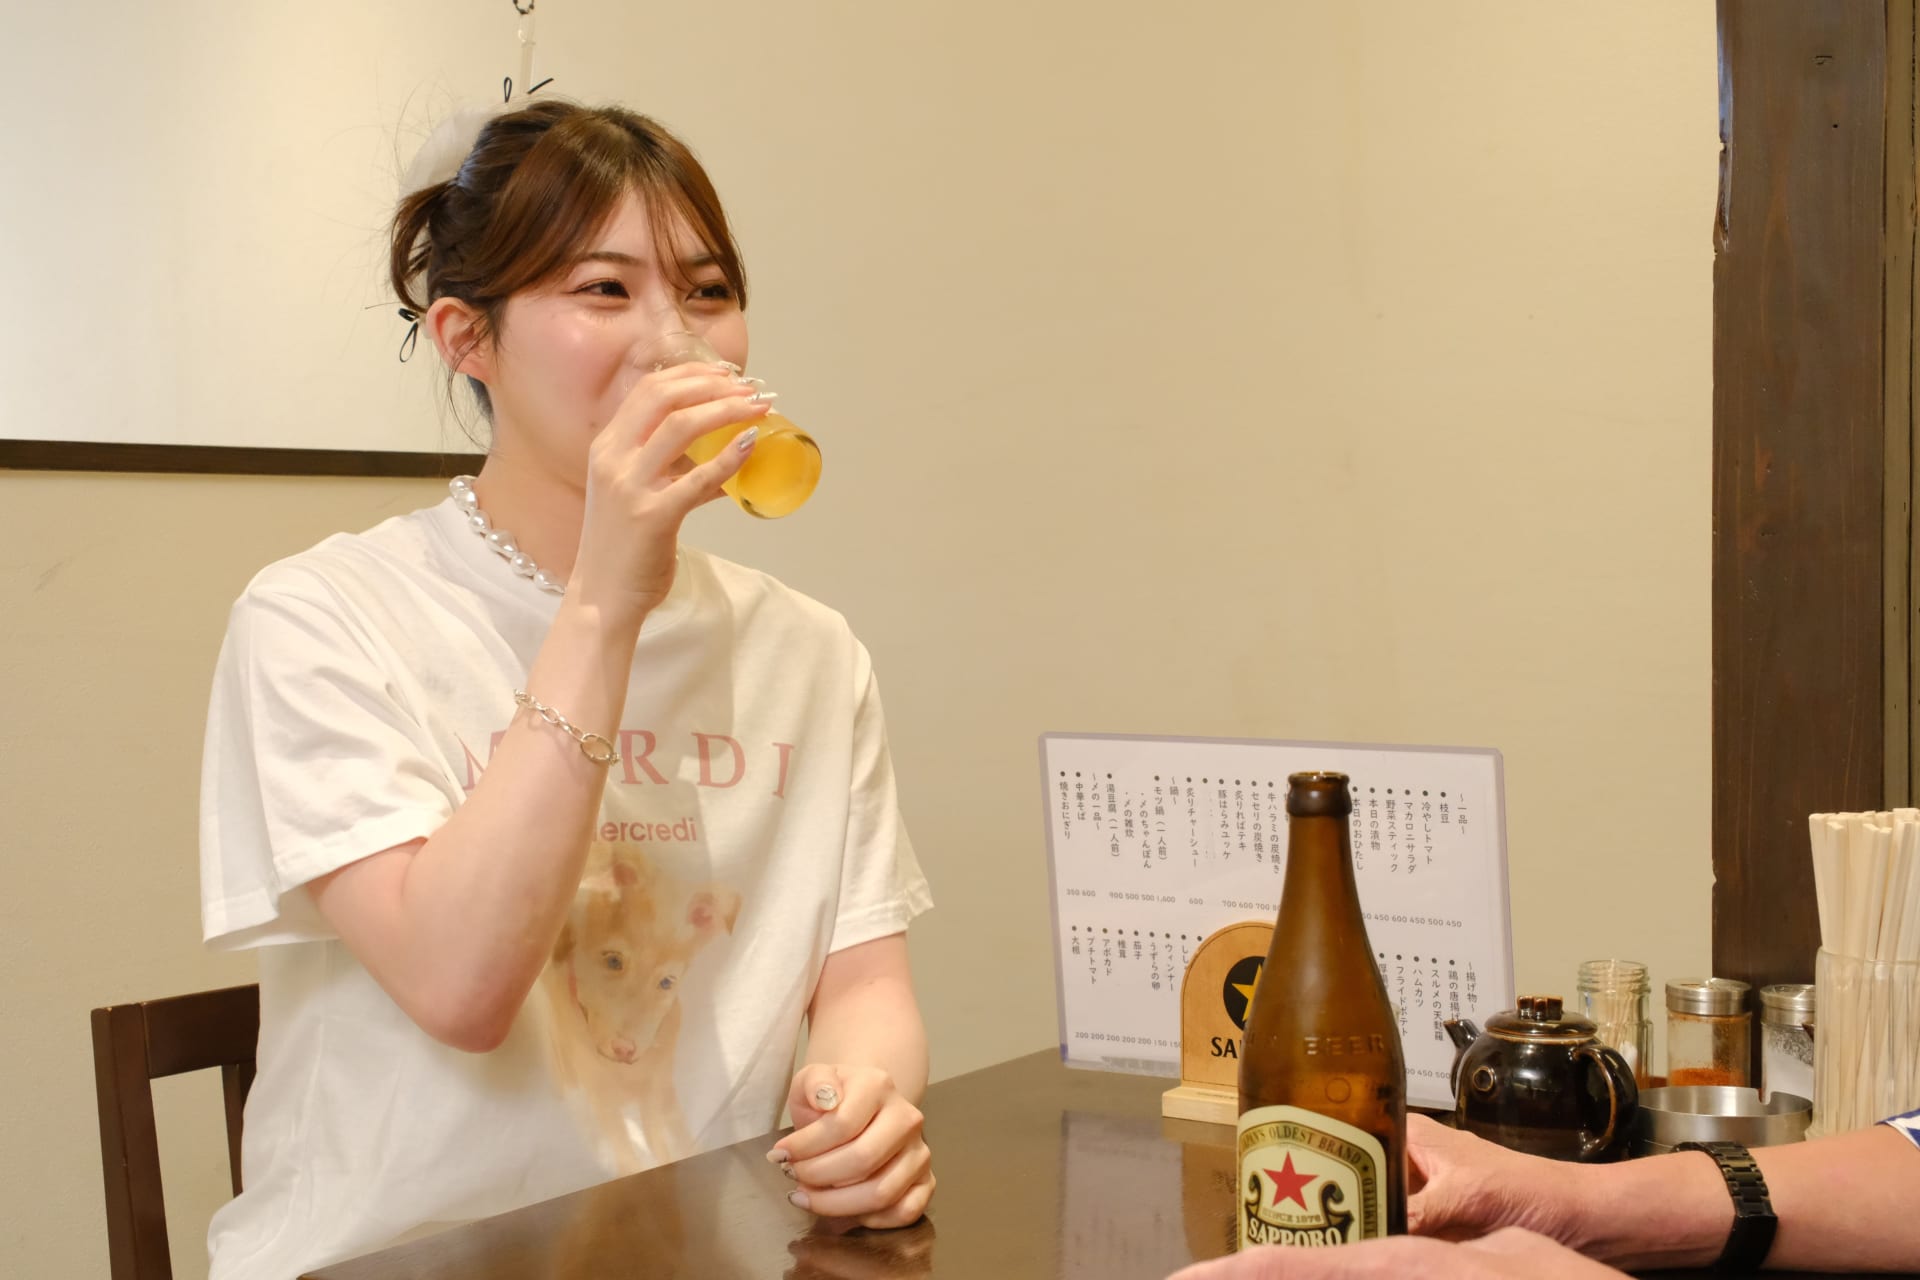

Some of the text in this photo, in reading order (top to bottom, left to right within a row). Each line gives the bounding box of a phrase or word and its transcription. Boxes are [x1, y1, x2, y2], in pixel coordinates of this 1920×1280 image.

[454, 729, 795, 800] MRDI
[1059, 781, 1071, 840] 焼きおにぎり
[1075, 782, 1086, 821] 中華そば
[1368, 799, 1381, 851] 本日の漬物
[1439, 803, 1450, 824] 枝豆
[593, 817, 697, 843] ercredi
[1251, 792, 1264, 863] セセリの炭焼き
[1267, 792, 1281, 875] 牛ハラミの炭焼き
[1351, 797, 1364, 871] 本日のおひたし
[1385, 799, 1398, 873] 野菜スティック
[1403, 801, 1417, 874] マカロニサラダ
[1421, 801, 1433, 865] 冷やしトマト
[1391, 915, 1408, 924] 600
[1427, 918, 1444, 927] 500
[1446, 920, 1462, 928] 450
[1087, 936, 1097, 985] プチトマト
[1102, 938, 1112, 977] アボカド
[1396, 966, 1408, 1037] フライドポテト
[1412, 969, 1424, 1008] ハムカツ
[1448, 970, 1460, 1020] 鶏の唐揚げ
[1268, 1125, 1314, 1145] OLDEST
[1249, 1217, 1343, 1247] SAPPORO
